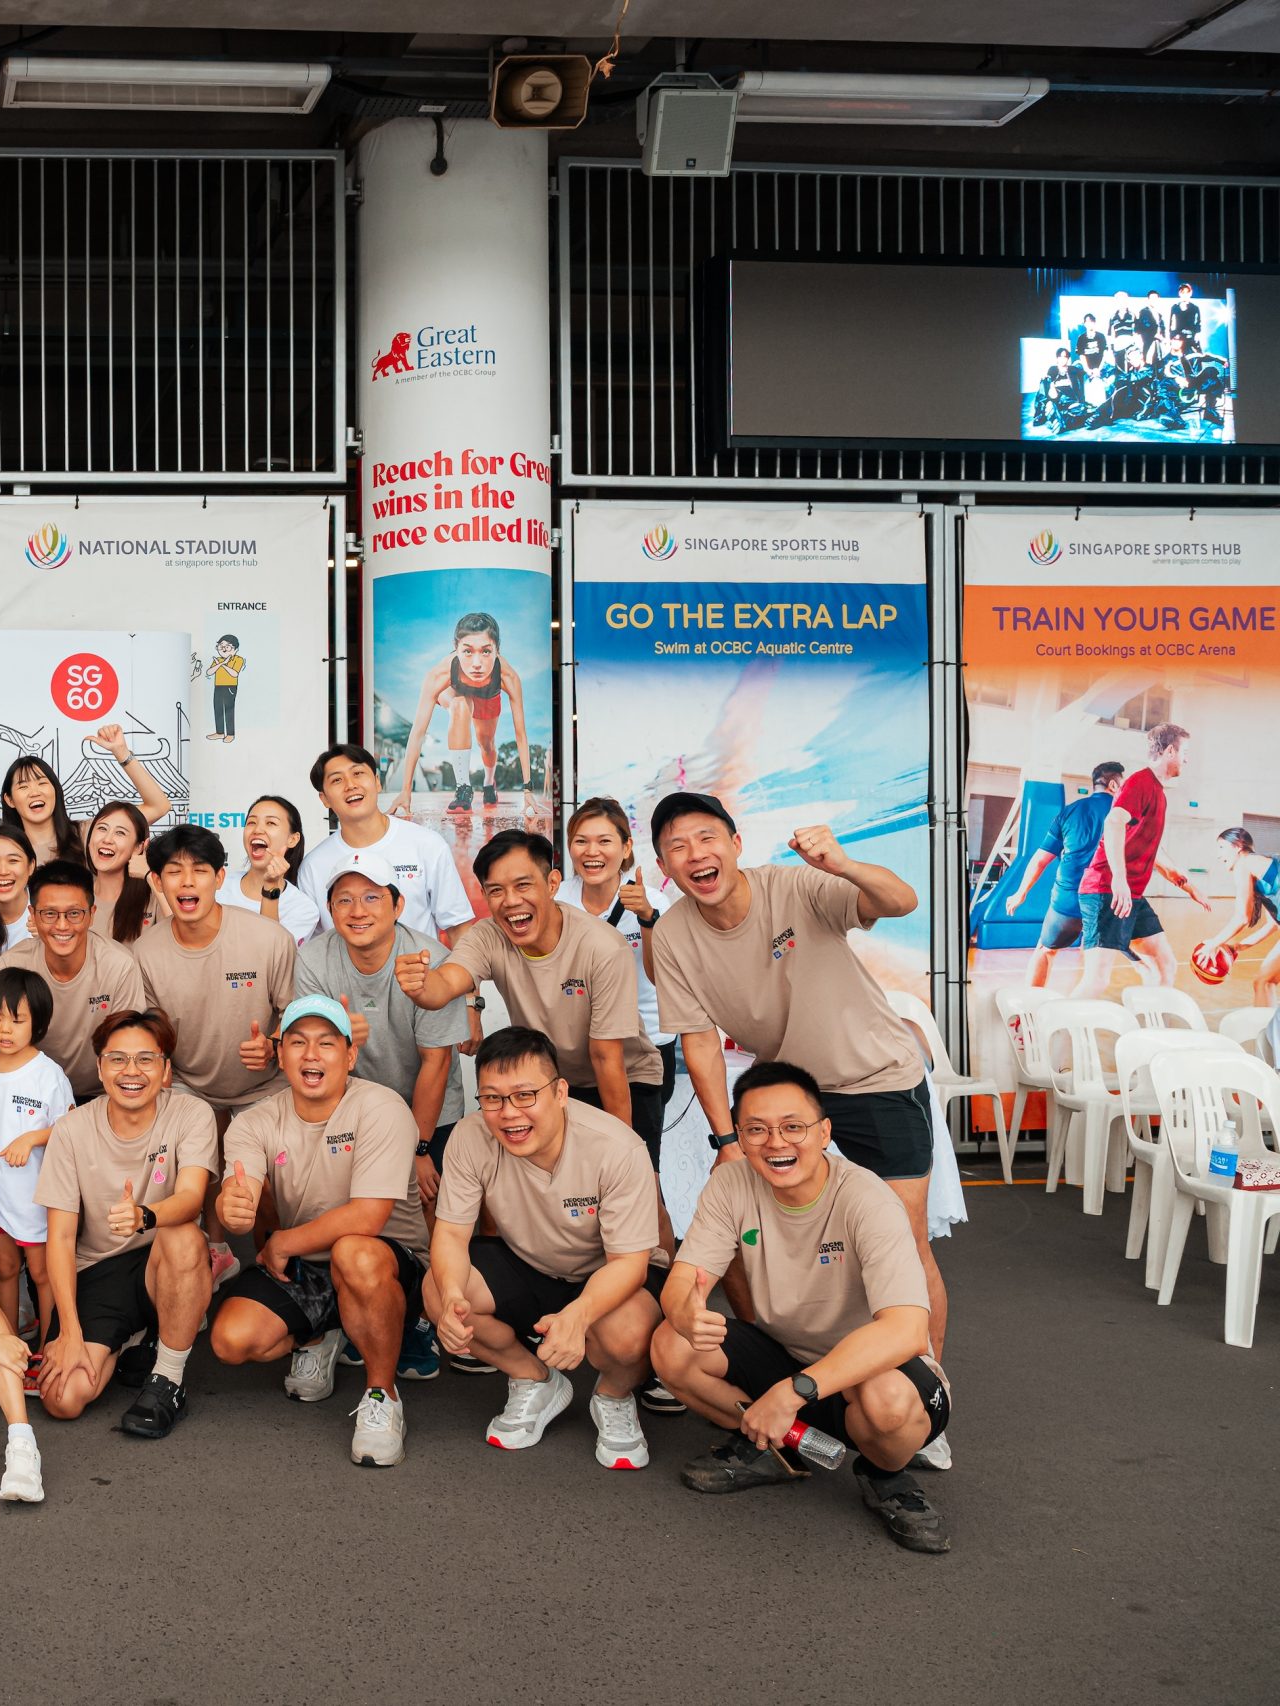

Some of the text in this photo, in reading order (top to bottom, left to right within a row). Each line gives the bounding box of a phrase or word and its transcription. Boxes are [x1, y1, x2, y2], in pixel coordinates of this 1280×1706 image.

[418, 325, 477, 347] Great
[418, 348, 496, 369] Eastern
[400, 374, 427, 383] member
[373, 449, 551, 488] Reach for Grea
[372, 482, 514, 520] wins in the
[373, 526, 427, 552] race
[434, 516, 522, 543] called
[79, 540, 256, 555] NATIONAL STADIUM
[685, 538, 859, 551] SINGAPORE SPORTS HUB
[1070, 543, 1240, 555] SINGAPORE SPORTS HUB
[175, 560, 213, 568] singapore
[216, 560, 240, 568] sports
[218, 602, 267, 611] ENTRANCE
[606, 603, 897, 629] GO THE EXTRA LAP
[992, 607, 1276, 631] TRAIN YOUR GAME
[655, 641, 853, 656] Swim at OCBC Aquatic Centre
[1036, 644, 1235, 658] Court Bookings at OCBC Arena
[67, 665, 102, 686] SG
[67, 687, 102, 710] 60
[189, 813, 214, 827] FIE
[13, 1096, 42, 1104] TEOCHEW
[326, 1132, 354, 1140] TEOCHEW
